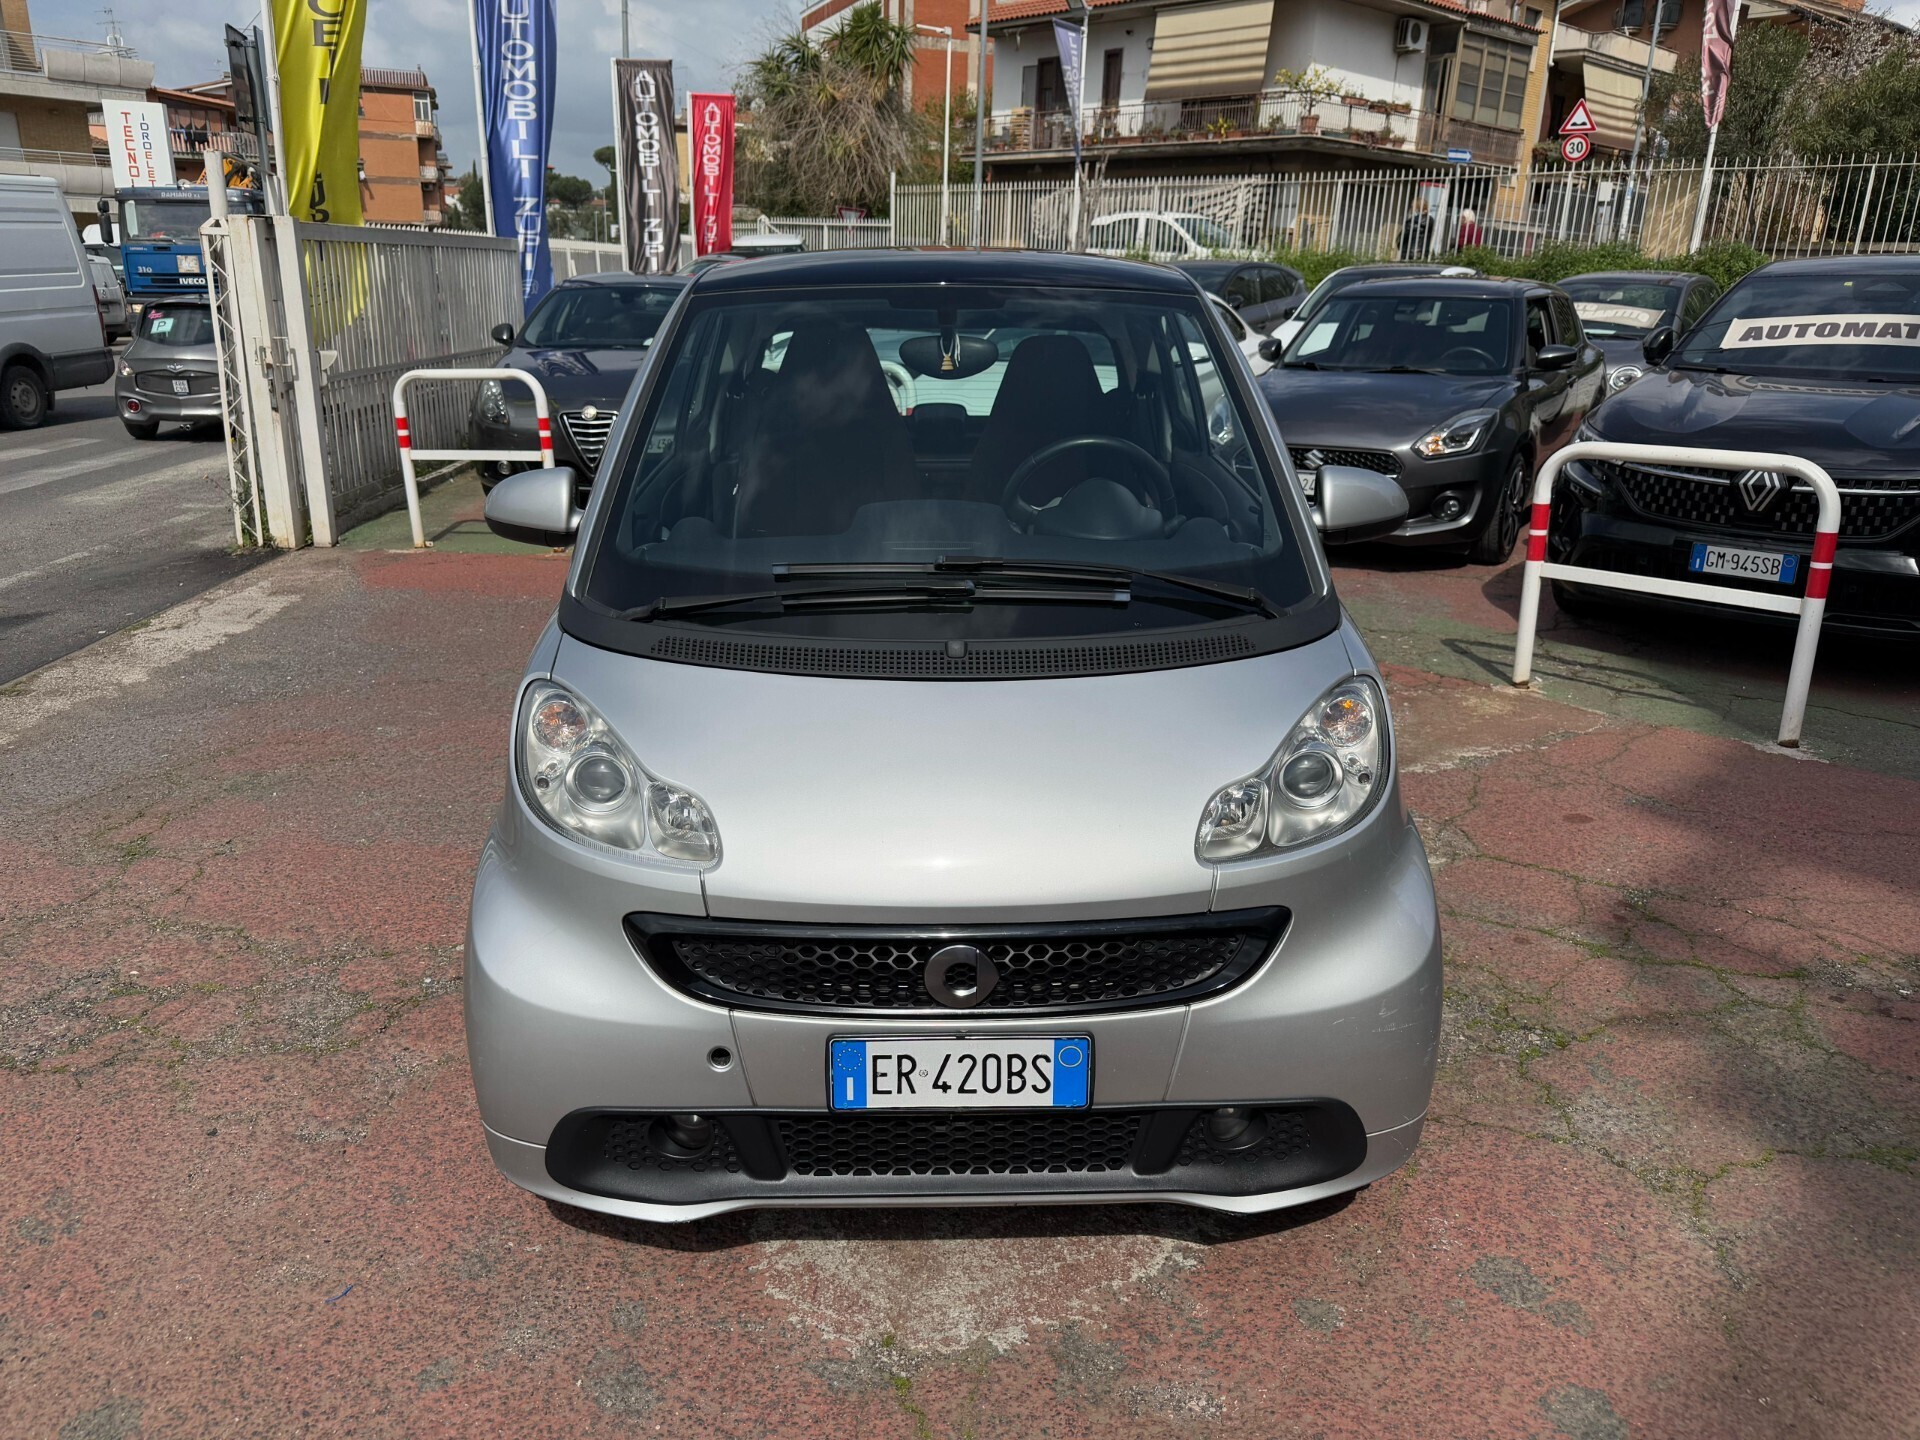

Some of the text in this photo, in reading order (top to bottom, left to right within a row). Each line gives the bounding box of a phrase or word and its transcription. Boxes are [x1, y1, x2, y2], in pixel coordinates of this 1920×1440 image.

[703, 102, 721, 206] AUTOMOBILI
[1568, 141, 1584, 155] 30
[633, 70, 665, 271] AUTOMOBILI ZUPI
[156, 320, 167, 331] P
[1738, 322, 1920, 341] AUTOMAT
